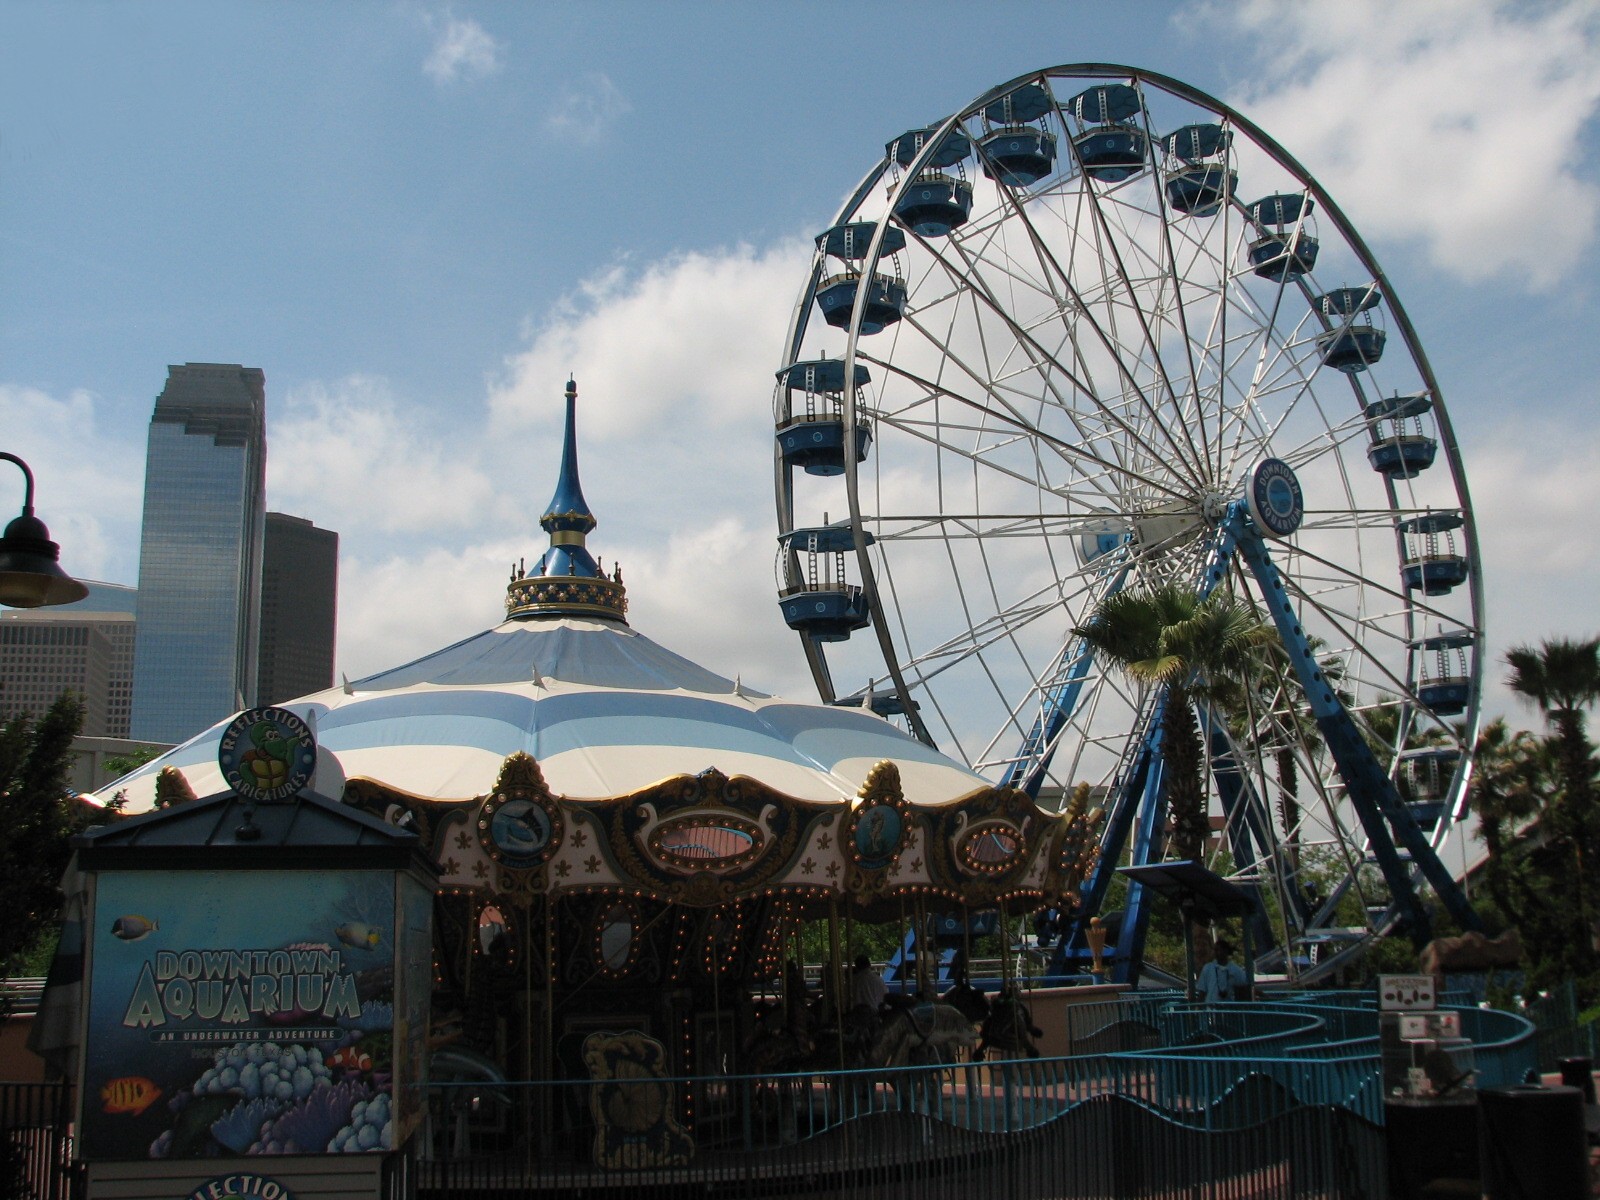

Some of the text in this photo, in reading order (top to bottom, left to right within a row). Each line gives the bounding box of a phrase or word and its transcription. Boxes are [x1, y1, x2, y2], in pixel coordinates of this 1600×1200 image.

[1260, 464, 1300, 495] DOWNTOWN
[1260, 500, 1301, 530] AQUARIUM
[223, 709, 313, 750] REFLECTIONS
[227, 770, 306, 800] CARICATURES
[157, 951, 340, 980] DOWNTOWN
[122, 960, 361, 1028] AQUARIUM
[160, 1030, 336, 1041] AN UNDERWATER ADVENTURE
[189, 1175, 289, 1200] ECTIO
